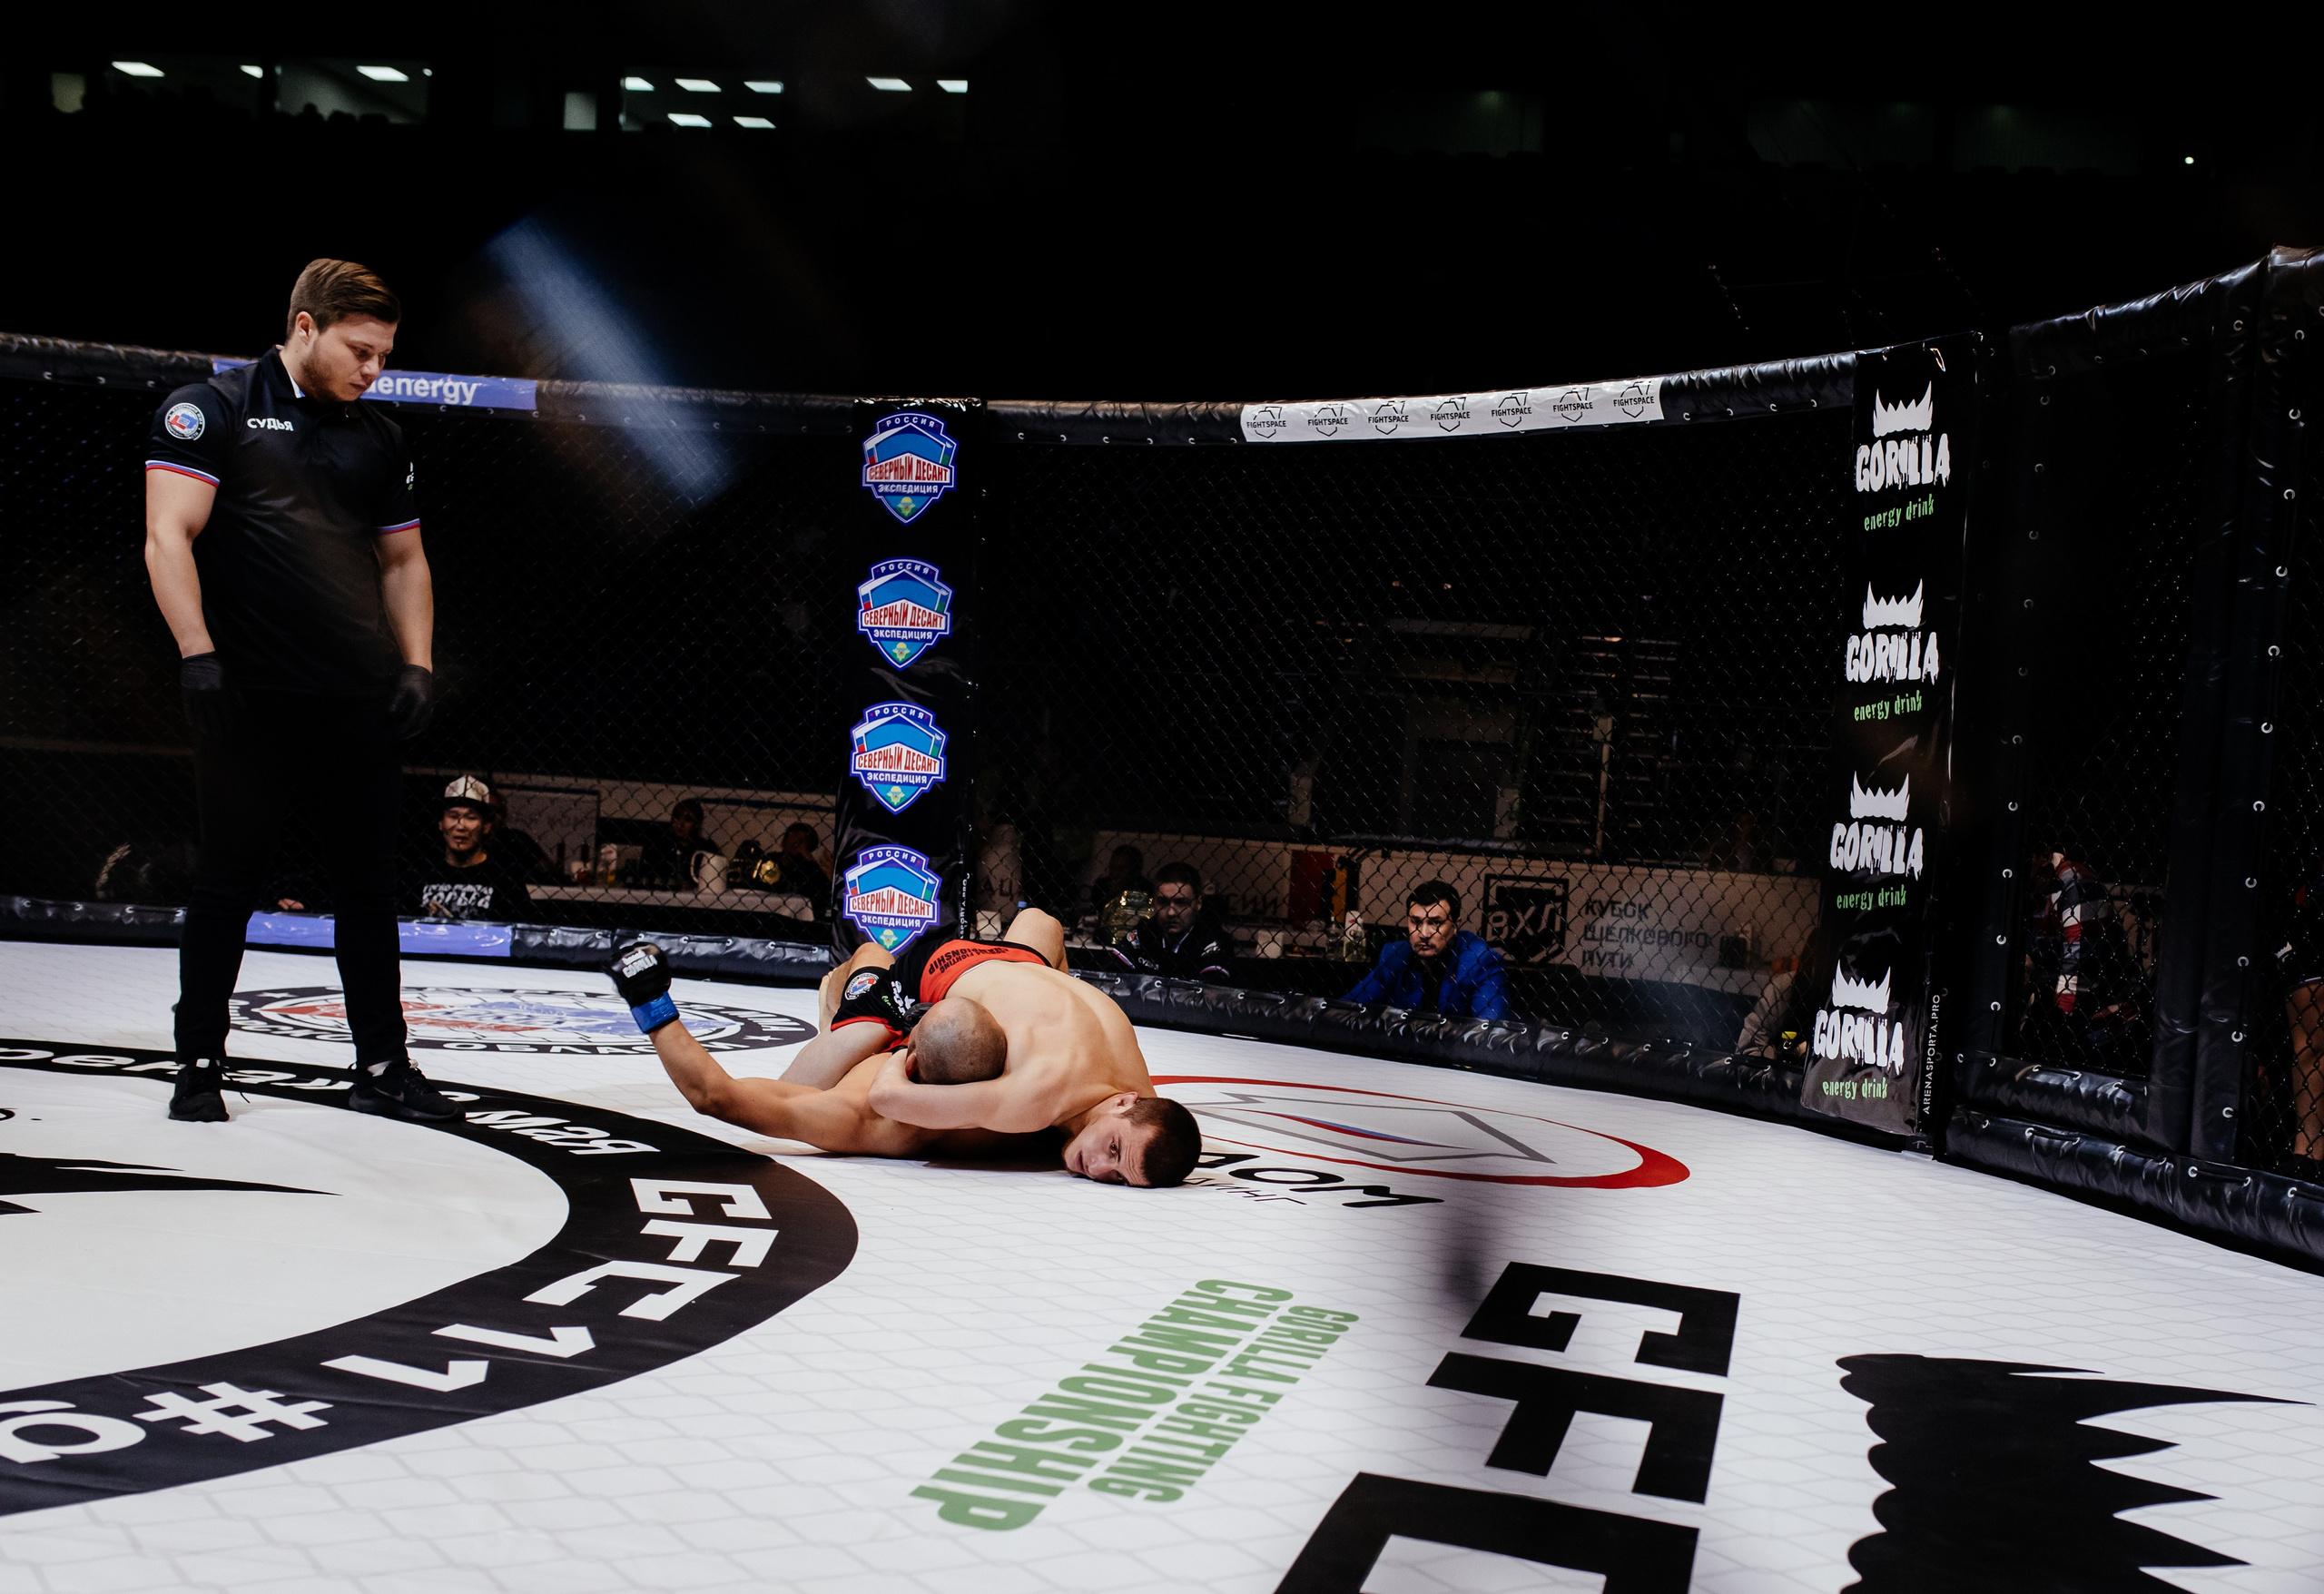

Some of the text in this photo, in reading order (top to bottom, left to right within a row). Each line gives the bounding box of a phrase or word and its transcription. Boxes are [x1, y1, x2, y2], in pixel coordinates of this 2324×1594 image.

[1492, 407, 1532, 418] FIGHTSPACE
[1553, 401, 1593, 413] FIGHTSPACE
[1613, 396, 1655, 408] FIGHTSPACE
[246, 417, 295, 432] СУДЬЯ
[886, 415, 935, 428] РОССИЯ
[1246, 419, 1286, 429] FIGHTSPACE
[1307, 418, 1349, 427] FIGHTSPACE
[1368, 415, 1409, 425] FIGHTSPACE
[1430, 411, 1471, 422] FIGHTSPACE
[869, 455, 949, 482] СЕВЕРНЫЙ ДЕСАНТ
[1855, 433, 1951, 493] GORILLA
[877, 484, 939, 494] ЭКСПЕДИЦИЯ
[1864, 493, 1935, 532] energy drink
[881, 562, 930, 575] РОССИЯ
[864, 602, 944, 628] СЕВЕРНЫЙ ДЕСАНТ
[873, 629, 933, 640] ЭКСПЕДИЦИЯ
[1846, 632, 1940, 685] GORILLA
[874, 706, 924, 720] РОССИЯ
[1854, 690, 1923, 722] energy drink
[858, 745, 938, 772] СЕВЕРНЫЙ ДЕСАНТ
[866, 772, 928, 784] ЭКСПЕДИЦИЯ
[868, 850, 918, 863] РОССИЯ
[1829, 822, 1924, 881] GORILLA
[852, 889, 931, 917] СЕВЕРНЫЙ ДЕСАНТ
[1837, 885, 1906, 911] energy drink
[1585, 899, 1650, 920] КУБОК
[862, 914, 921, 928] ЭКСПЕДИЦИЯ
[442, 1041, 751, 1054] ОБЛАСИ
[1813, 1009, 1905, 1075] GORILLA
[1923, 994, 1941, 1115] ARENASPORTA.PRO
[1822, 1077, 1888, 1100] energy drink
[521, 1178, 779, 1321] GFC
[320, 1323, 596, 1392] 11
[909, 1279, 1295, 1531] CHAMPIONSHIP
[1088, 1304, 1360, 1503] GORILLA FIGHTING
